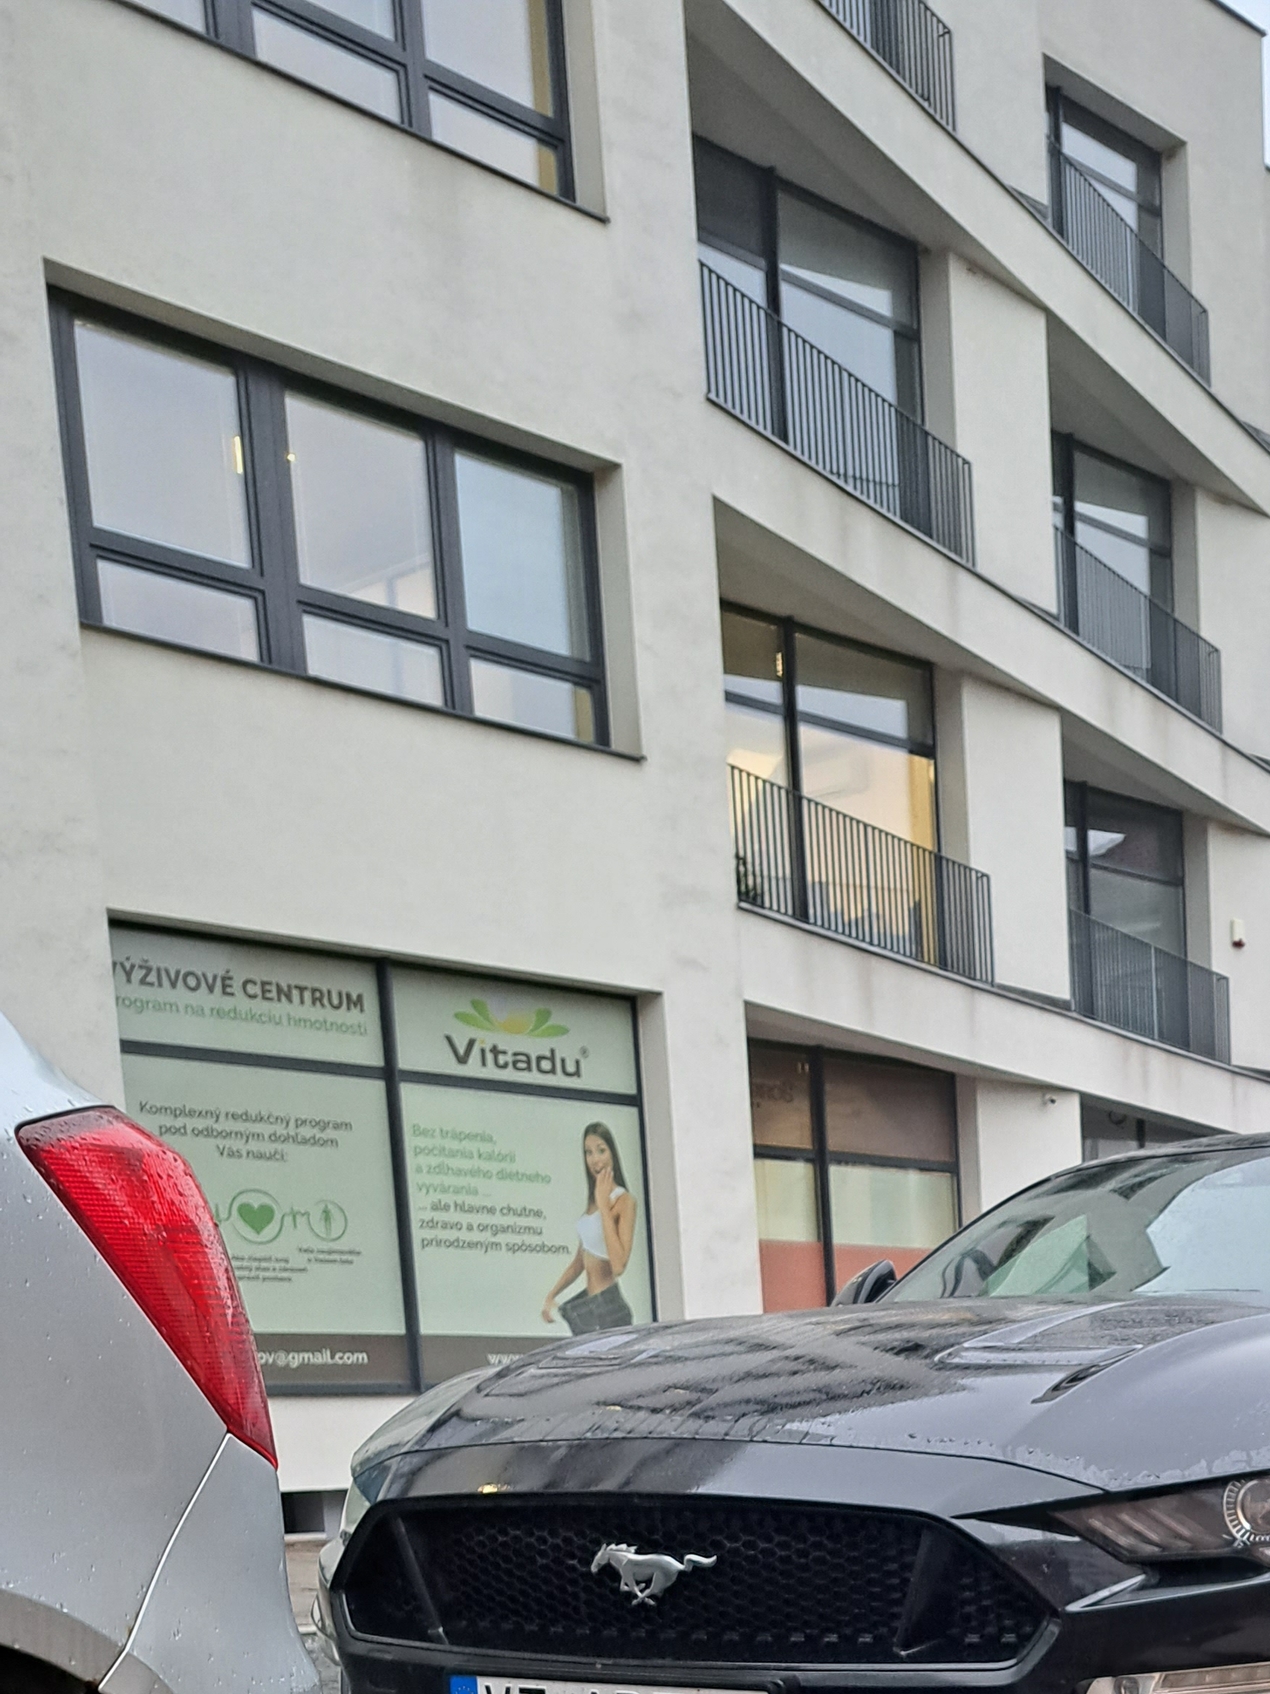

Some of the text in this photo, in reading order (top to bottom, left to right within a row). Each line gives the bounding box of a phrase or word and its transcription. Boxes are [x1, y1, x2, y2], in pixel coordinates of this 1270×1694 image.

[241, 977, 365, 1014] CENTRUM
[184, 1003, 205, 1018] na
[209, 1005, 283, 1026] redukciu
[287, 1011, 367, 1037] hmotnosti
[444, 1032, 582, 1079] Vitadu
[139, 1100, 221, 1123] Komplexný
[294, 1116, 353, 1134] program
[159, 1122, 188, 1137] pod
[191, 1124, 266, 1146] odborným
[411, 1122, 437, 1139] Bez
[216, 1144, 243, 1159] Vás
[430, 1199, 451, 1213] ale
[453, 1199, 498, 1216] hlavne
[418, 1216, 543, 1237] zdravo a organizmu
[420, 1234, 503, 1254] prirodzeným
